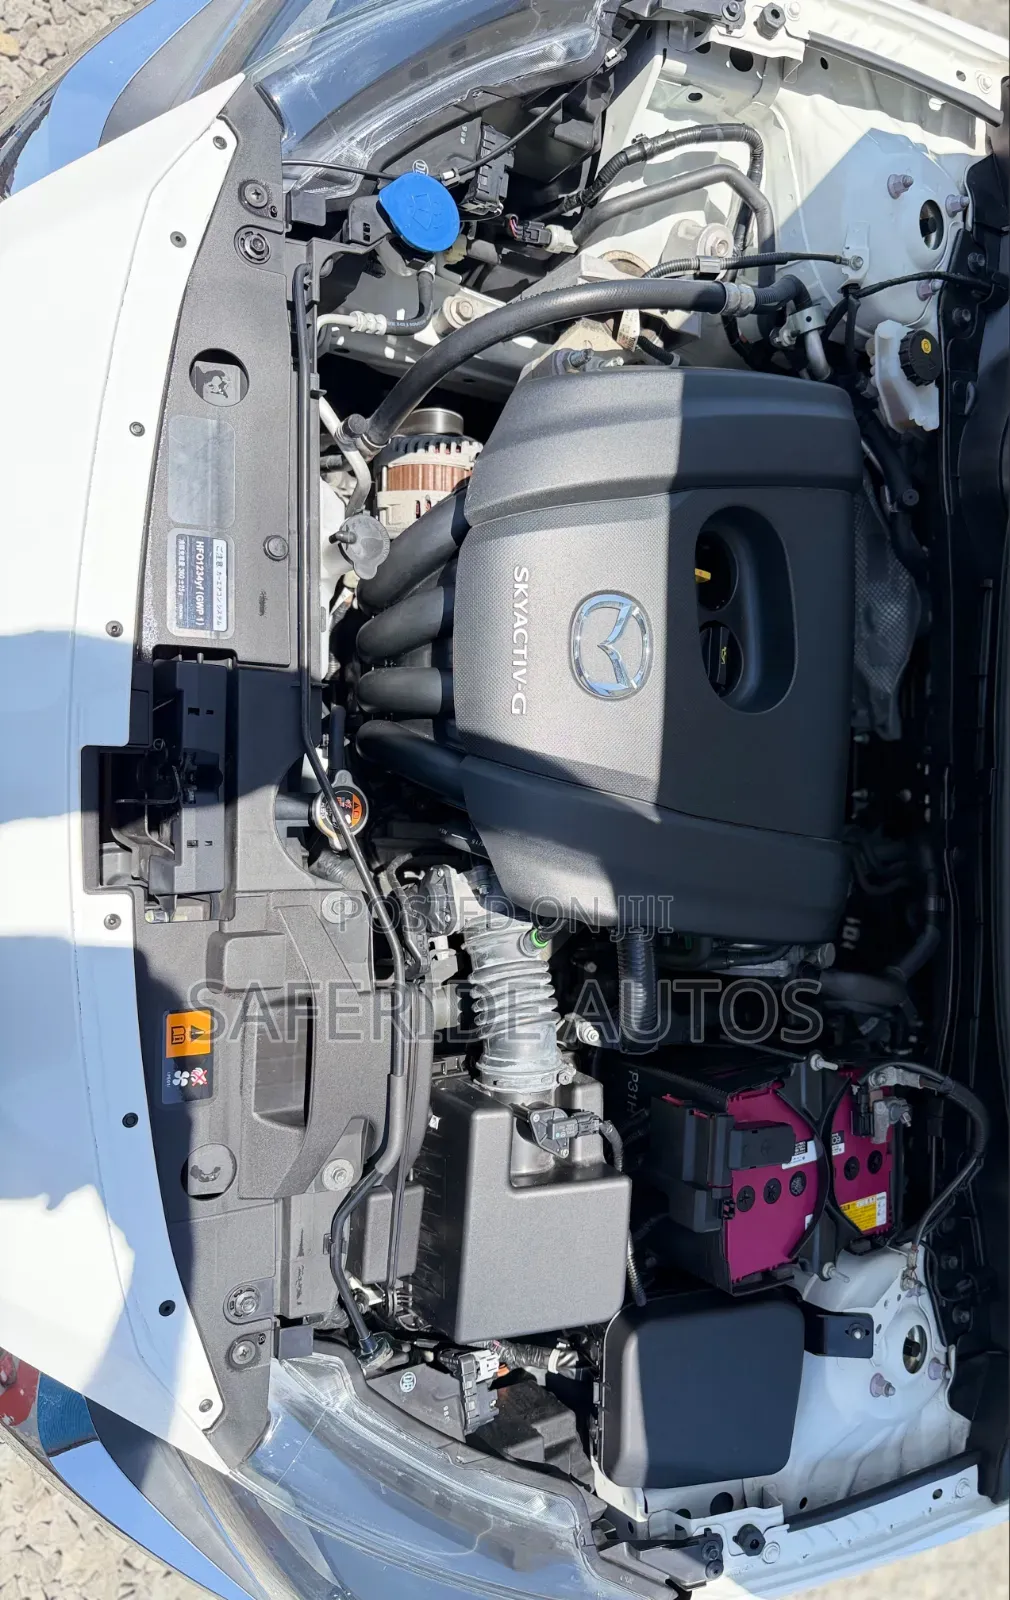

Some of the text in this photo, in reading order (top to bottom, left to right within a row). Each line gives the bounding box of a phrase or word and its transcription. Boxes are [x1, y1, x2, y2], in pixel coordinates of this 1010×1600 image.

[194, 541, 205, 626] HFO1234yf (GWP 1)
[511, 566, 529, 715] SKYACTIV-G
